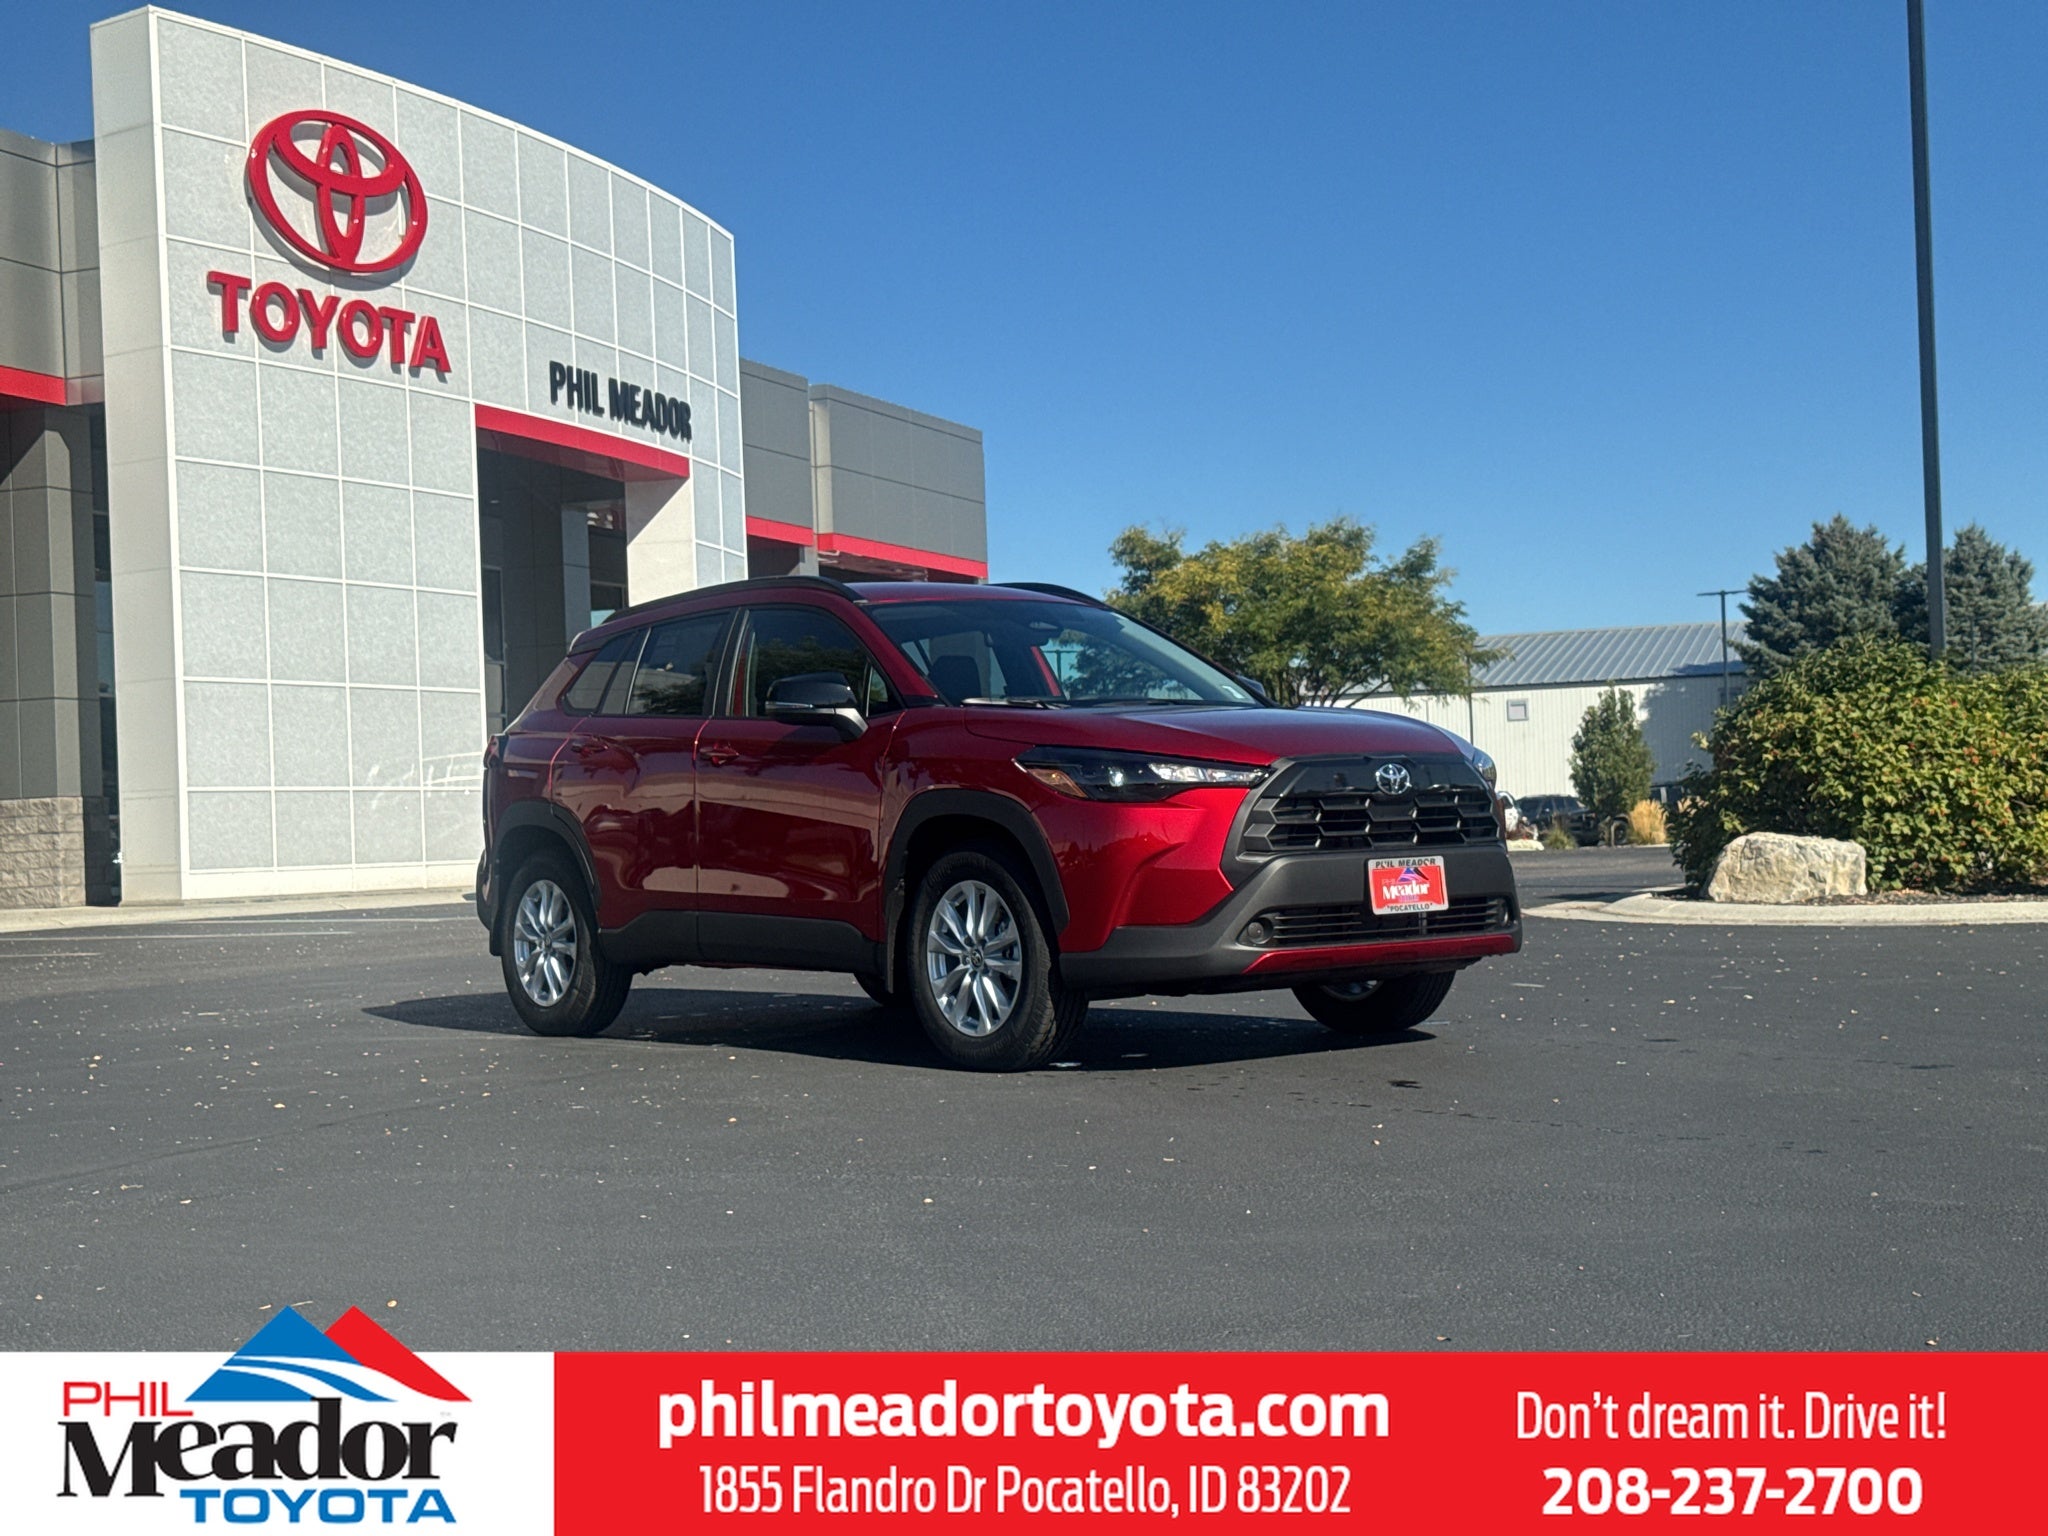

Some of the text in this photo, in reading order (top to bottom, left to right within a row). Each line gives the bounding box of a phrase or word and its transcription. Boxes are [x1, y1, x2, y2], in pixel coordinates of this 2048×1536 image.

[207, 270, 451, 374] TOYOTA
[549, 360, 692, 444] PHIL MEADOR
[1398, 858, 1436, 867] MEADOR
[1382, 880, 1430, 900] Meador
